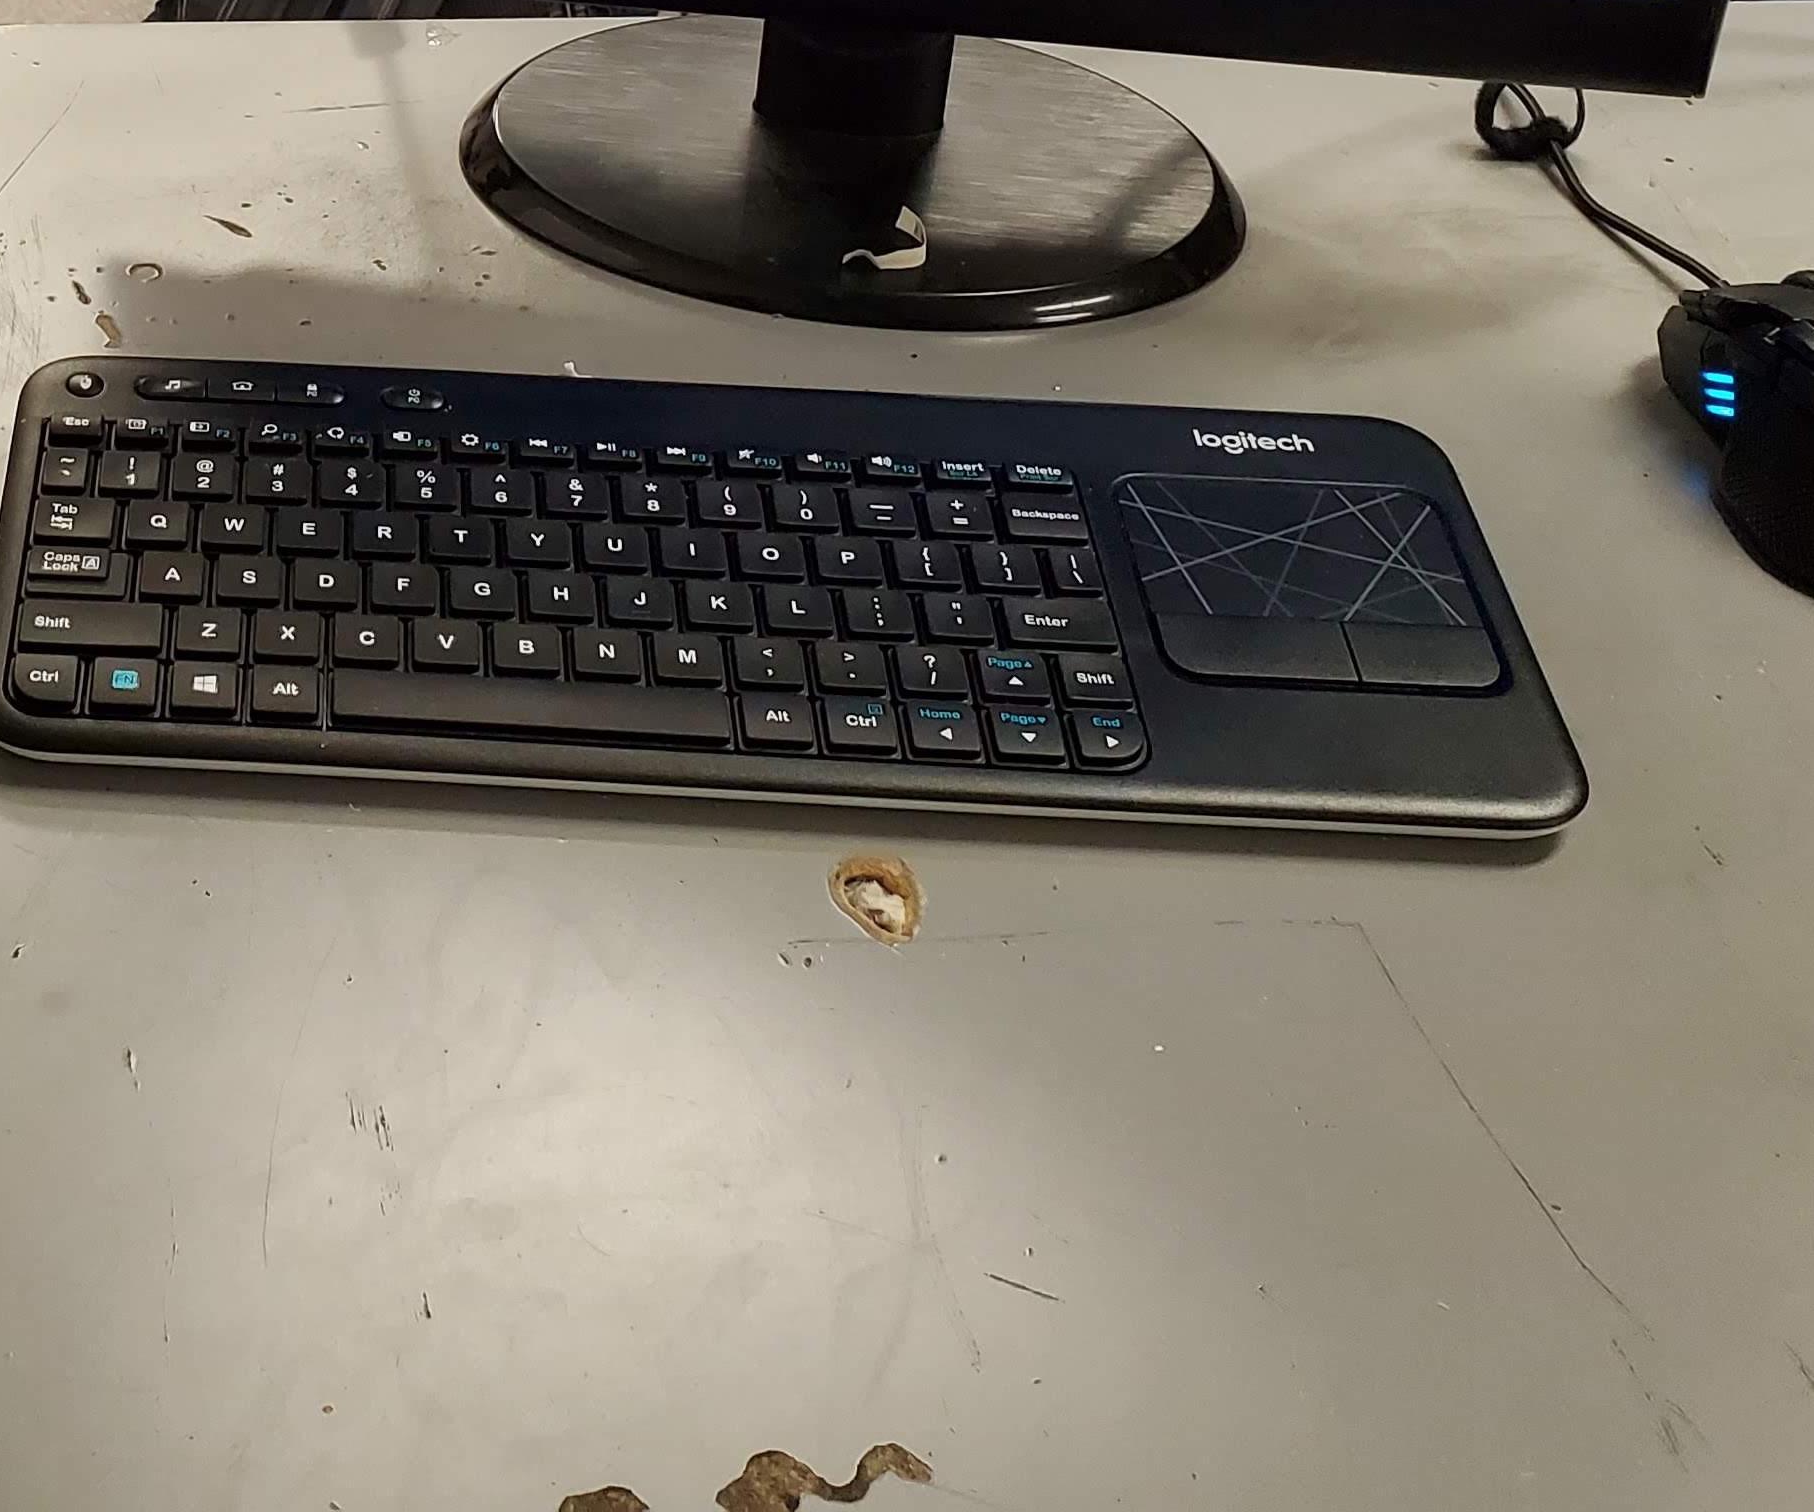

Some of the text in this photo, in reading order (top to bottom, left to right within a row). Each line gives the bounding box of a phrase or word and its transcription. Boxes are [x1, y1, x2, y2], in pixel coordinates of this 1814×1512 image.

[63, 416, 89, 426] Esc
[151, 427, 164, 436] F1
[216, 428, 230, 438] F2
[283, 431, 297, 441] F3
[350, 435, 364, 445] F4
[1193, 429, 1314, 454] logitech
[554, 446, 568, 454] F7
[754, 457, 776, 467] F10
[825, 461, 846, 470] F11
[894, 464, 915, 473] F12
[942, 460, 984, 473] Insert
[1016, 464, 1062, 476] Delete
[197, 476, 210, 488] 2
[272, 480, 284, 492] 3
[345, 484, 358, 496] 4
[420, 487, 433, 499] 5
[495, 491, 508, 503] 6
[571, 495, 583, 507] 7
[52, 503, 78, 515] Tab
[647, 500, 659, 511] 8
[724, 504, 736, 516] 9
[1012, 508, 1079, 521] Backspace
[150, 515, 167, 528] Q
[224, 518, 245, 532] W
[303, 522, 316, 536] E
[378, 525, 392, 539] R
[454, 530, 468, 543] T
[530, 533, 545, 547] Y
[608, 538, 622, 551] U
[43, 551, 81, 564] Caps
[841, 551, 855, 564] P
[42, 560, 78, 572] Lock
[164, 567, 180, 581] A
[243, 570, 256, 584] S
[319, 574, 334, 587] D
[397, 578, 410, 591] F
[474, 582, 491, 596] G
[553, 587, 569, 600] H
[634, 592, 646, 606] J
[710, 596, 728, 611] K
[791, 600, 805, 614] L
[34, 616, 70, 629] Shift
[1024, 614, 1068, 628] Enter
[201, 623, 217, 637] Z
[281, 626, 295, 640] X
[359, 631, 375, 645] C
[438, 635, 454, 649] V
[518, 640, 534, 654] B
[599, 644, 615, 659] N
[678, 650, 697, 664] M
[988, 656, 1022, 669] Page
[30, 670, 58, 683] Ctrl
[1076, 672, 1114, 686] Shift
[273, 682, 299, 696] Alt
[766, 709, 791, 722] Alt
[845, 713, 877, 727] Ctrl
[919, 707, 961, 720] Home
[1000, 712, 1036, 725] Page
[1092, 716, 1121, 728] End
